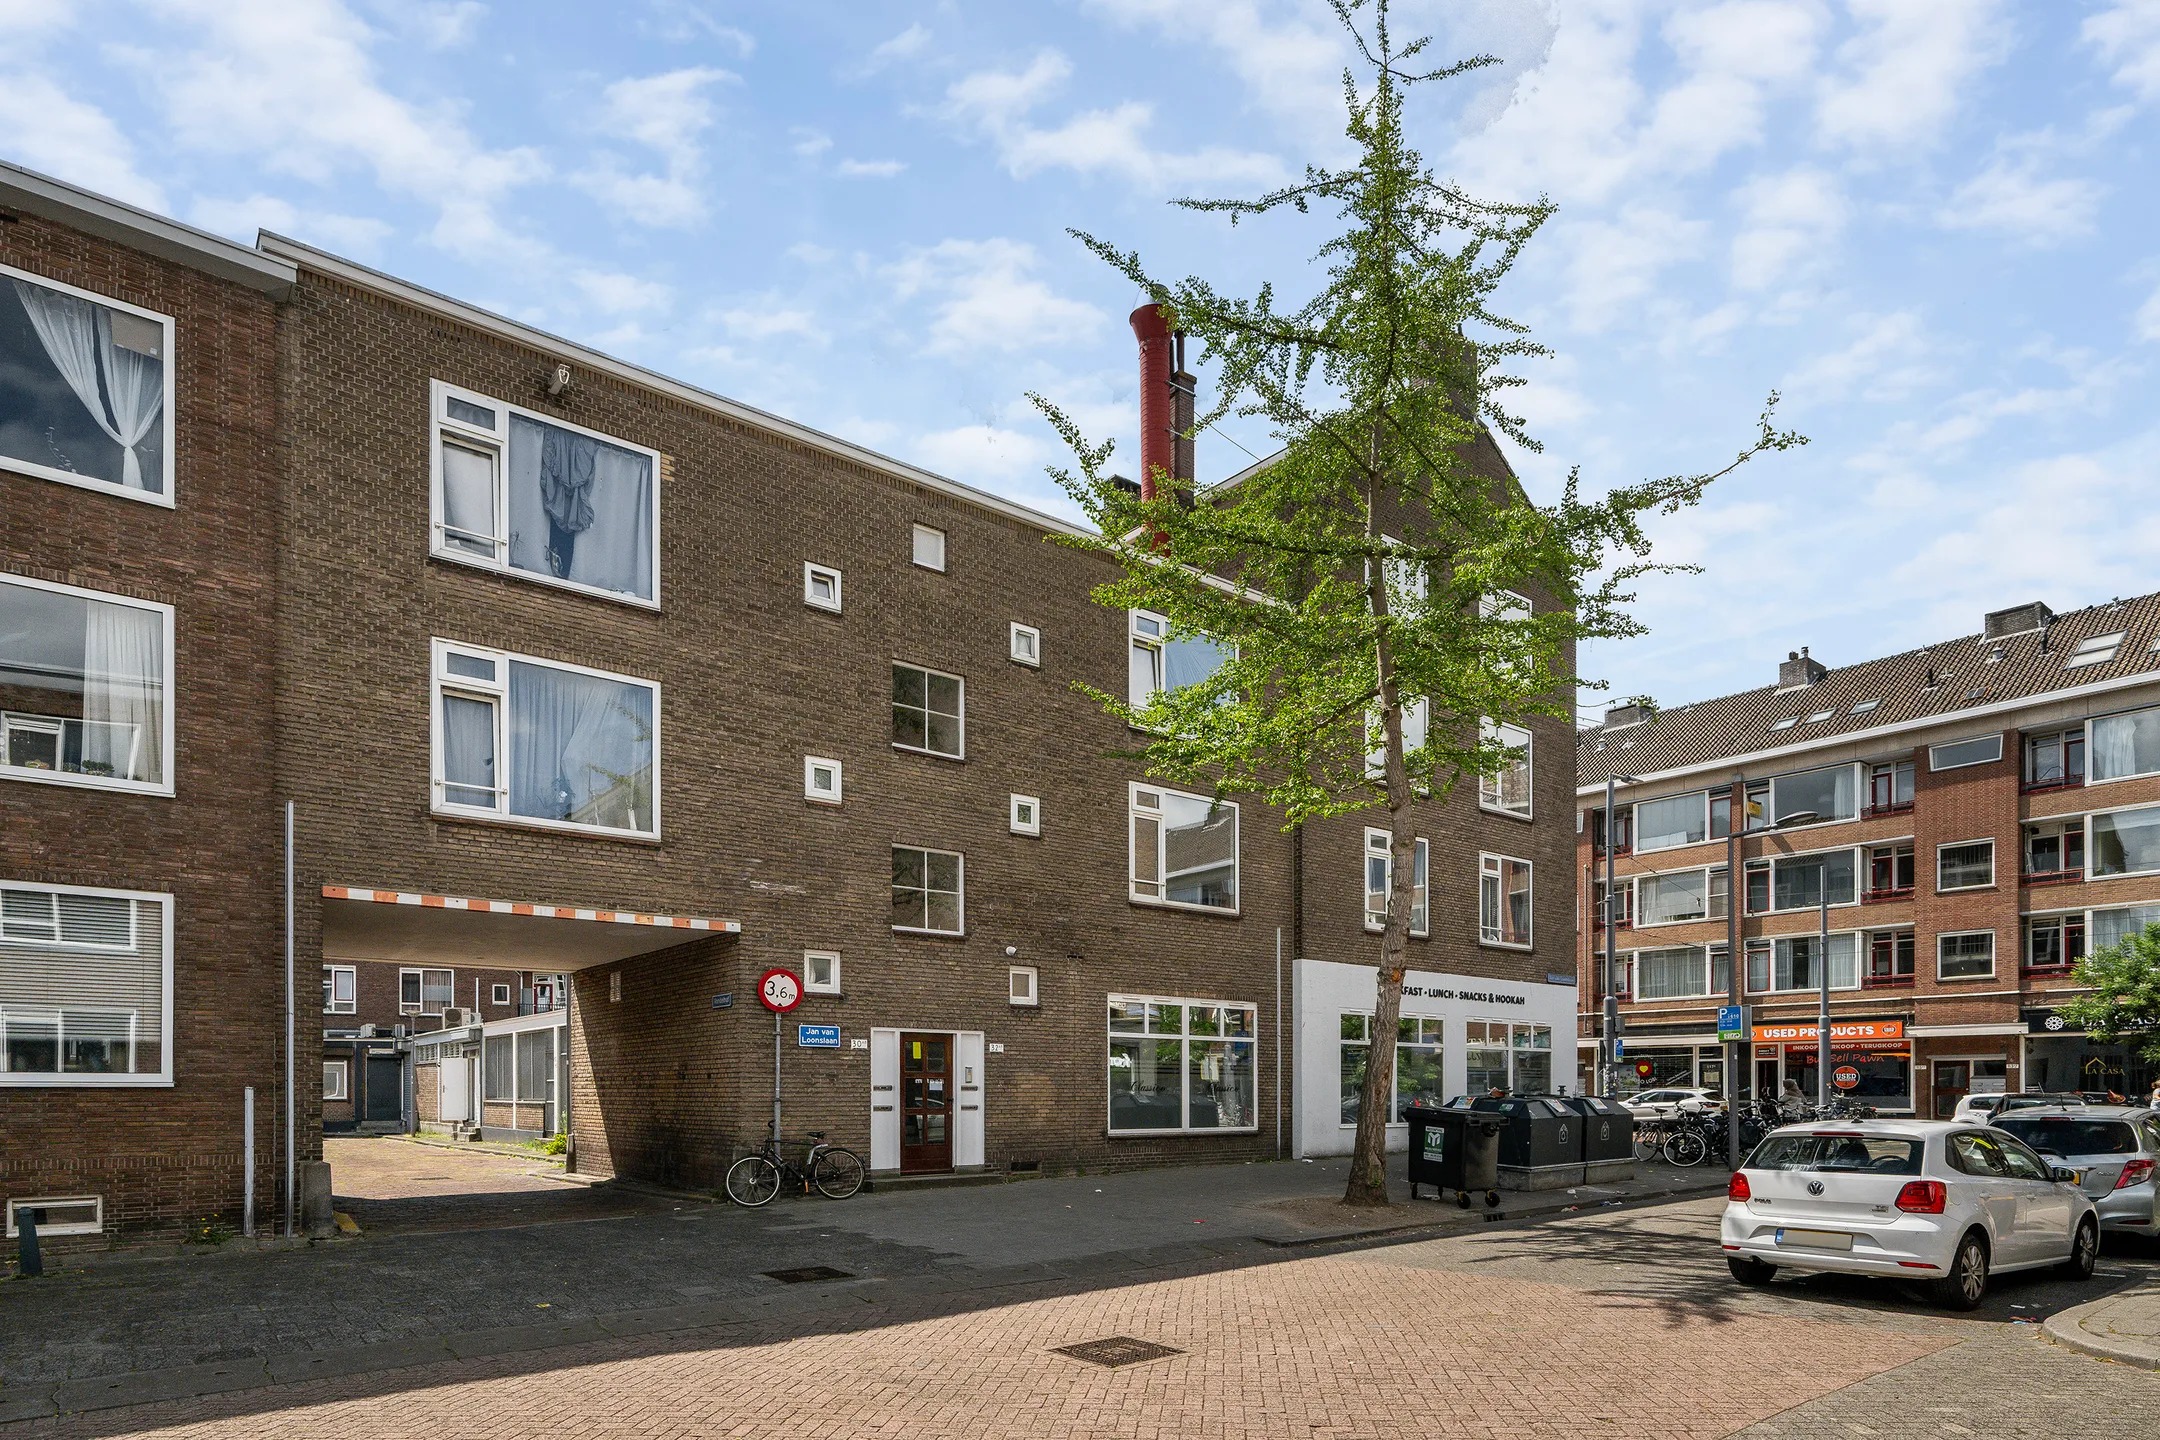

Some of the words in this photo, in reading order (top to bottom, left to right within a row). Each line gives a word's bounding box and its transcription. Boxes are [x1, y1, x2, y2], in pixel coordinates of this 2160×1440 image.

[1428, 988, 1454, 999] LUNCH
[1459, 991, 1487, 1002] SNACKS
[1488, 993, 1495, 1003] &
[1495, 994, 1525, 1005] HOOKAH
[1720, 1008, 1728, 1019] P
[805, 1027, 820, 1035] Jan
[1763, 1028, 1797, 1038] USED
[1799, 1025, 1875, 1037] PRDUCTS
[801, 1036, 838, 1045] Loonslaan
[1806, 1055, 1819, 1064] Bu
[1830, 1053, 1849, 1063] Sell
[1852, 1053, 1885, 1063] Pawn
[2100, 1068, 2125, 1076] CASA
